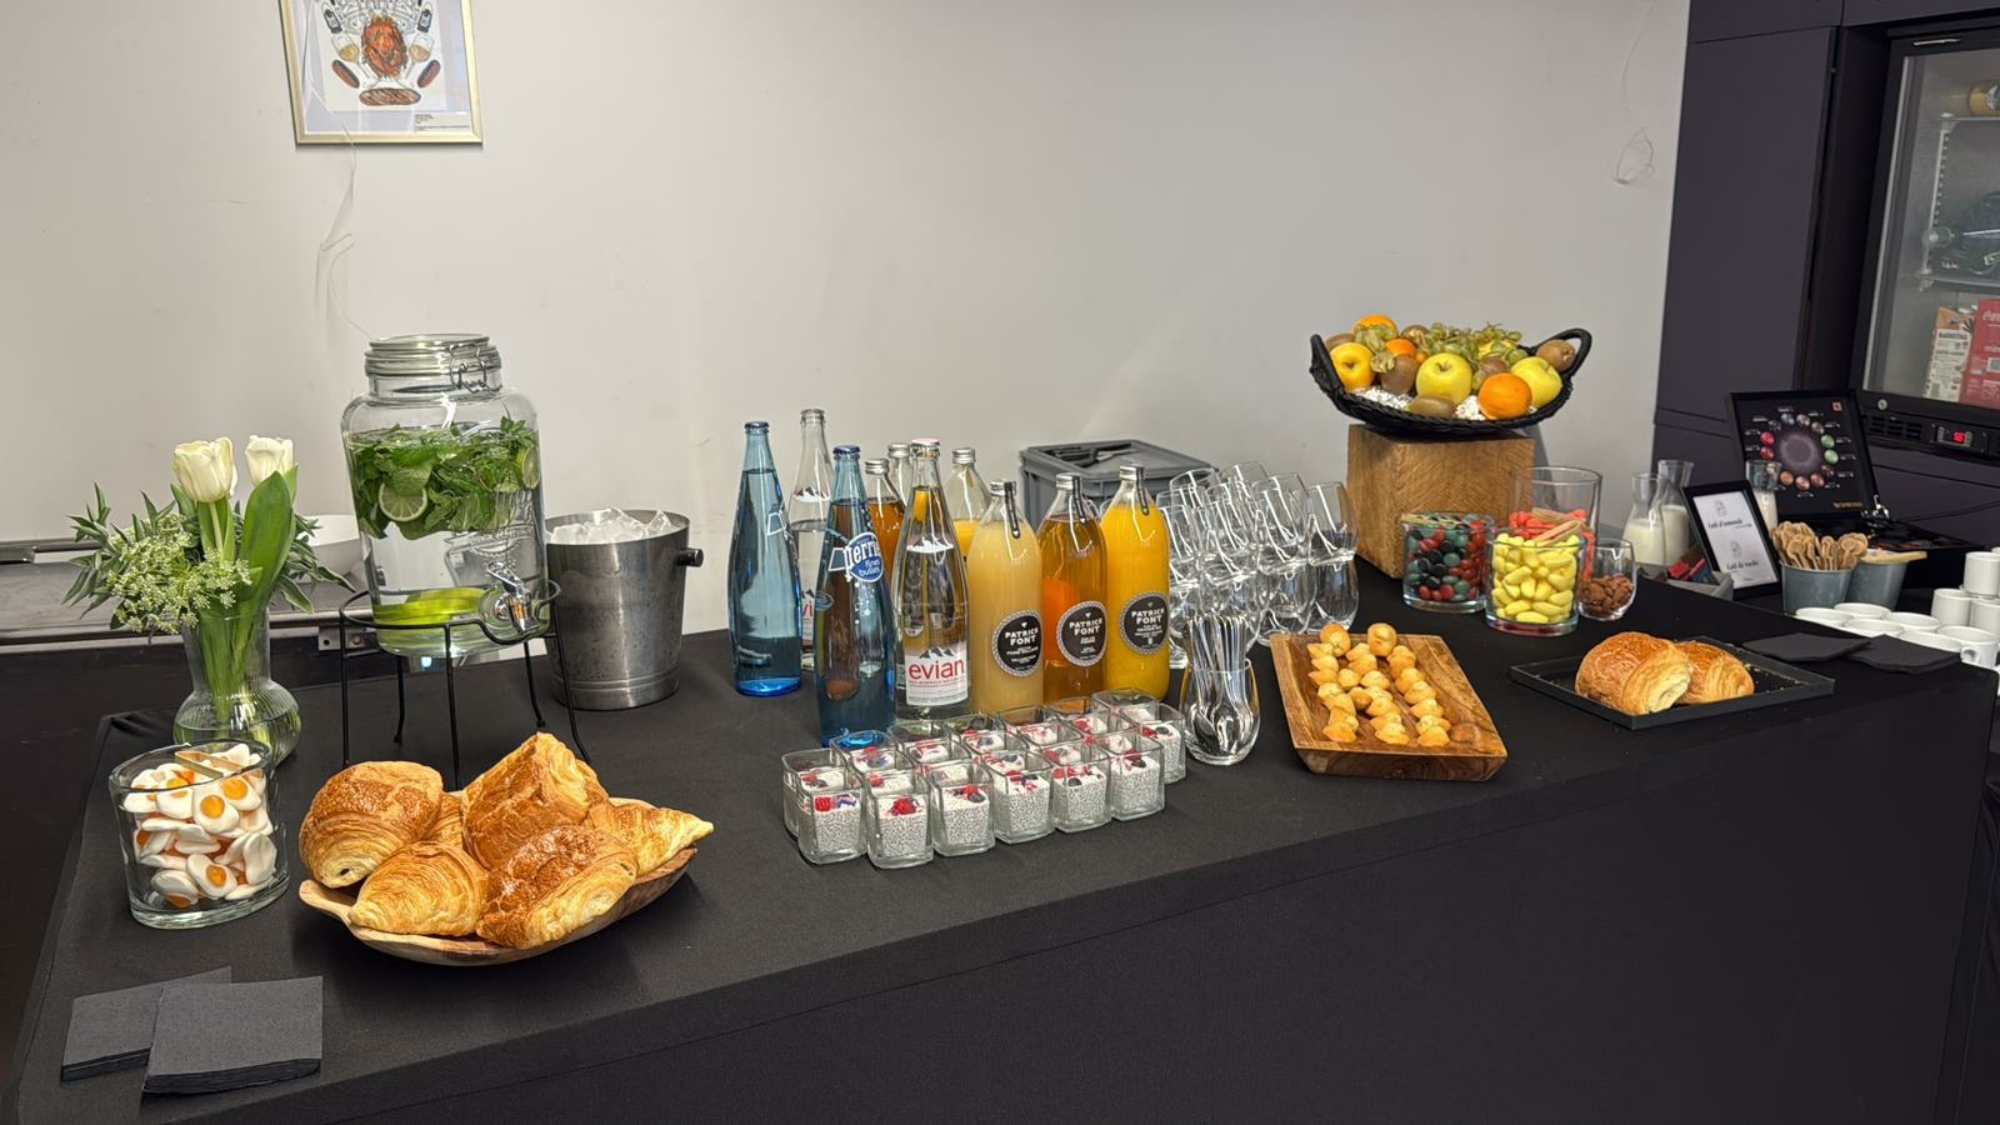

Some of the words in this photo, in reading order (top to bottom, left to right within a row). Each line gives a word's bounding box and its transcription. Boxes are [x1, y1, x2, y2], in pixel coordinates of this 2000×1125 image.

[1069, 617, 1103, 629] PATRICK
[1136, 615, 1162, 625] FONT
[1004, 626, 1039, 639] PATRICK
[1074, 625, 1100, 636] FONT
[1010, 635, 1036, 646] FONT
[908, 659, 965, 680] evian
